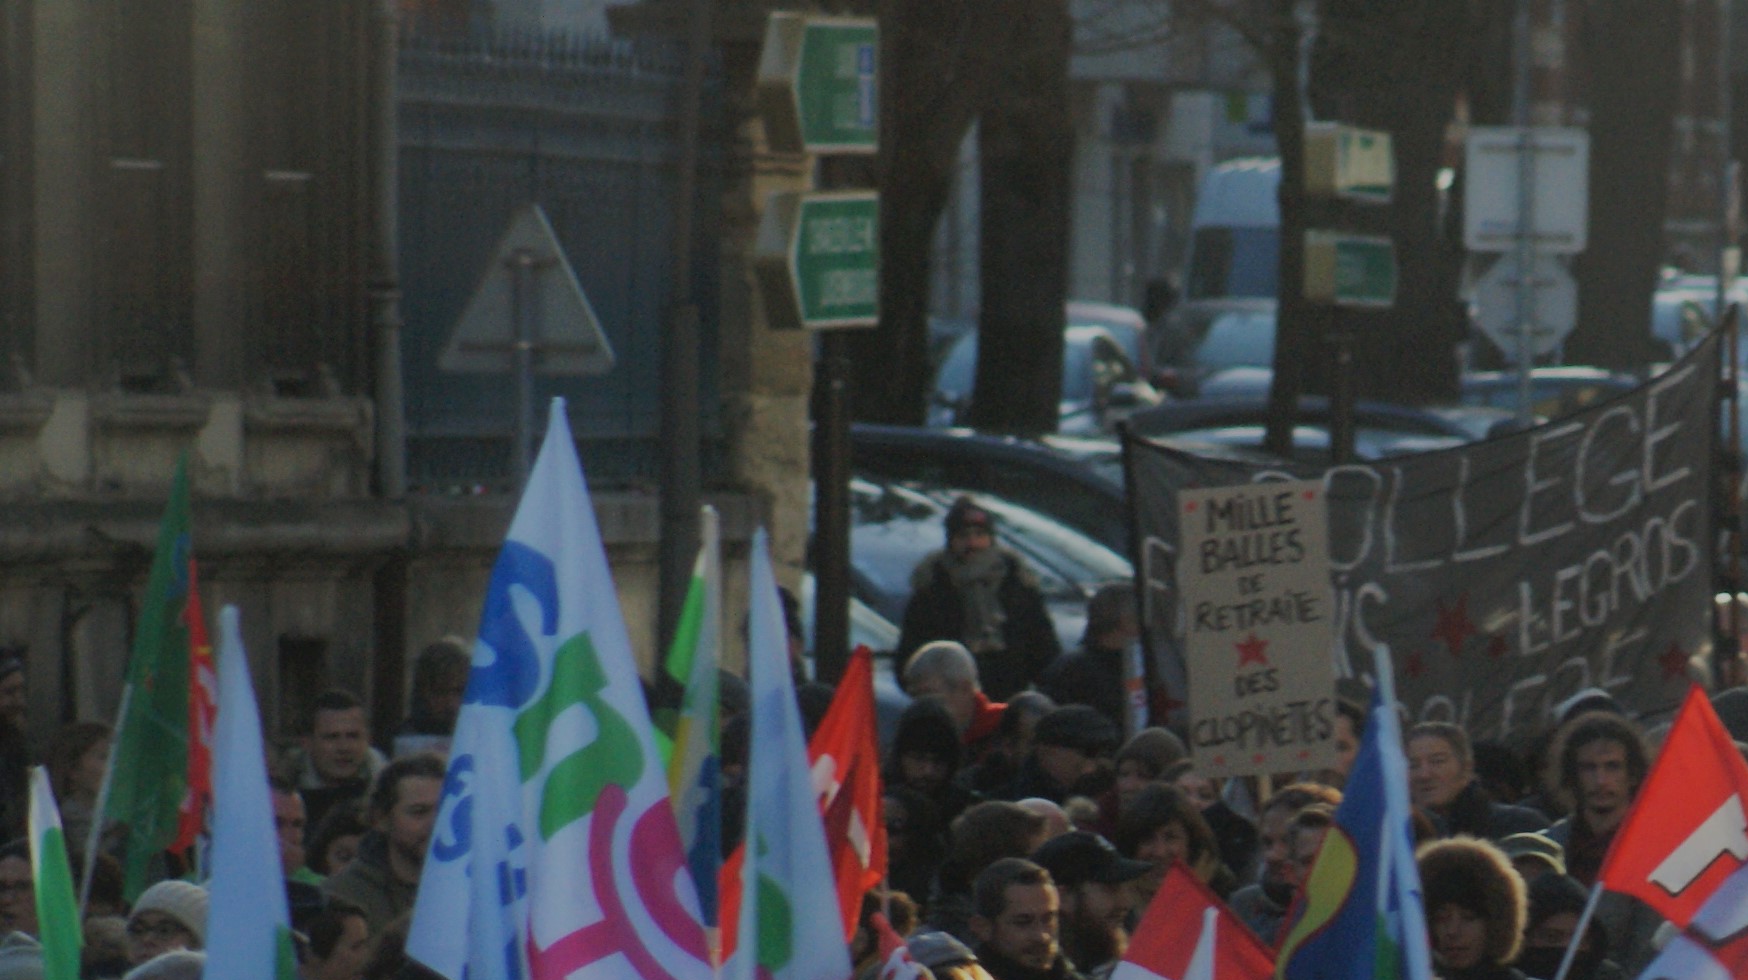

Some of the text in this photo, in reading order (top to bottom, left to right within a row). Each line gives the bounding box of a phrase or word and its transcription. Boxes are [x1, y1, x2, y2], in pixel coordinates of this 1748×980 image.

[1253, 363, 1698, 573] OLLEGE
[1200, 528, 1305, 575] BALLES
[1238, 574, 1265, 596] DE
[1234, 667, 1280, 698] DES
